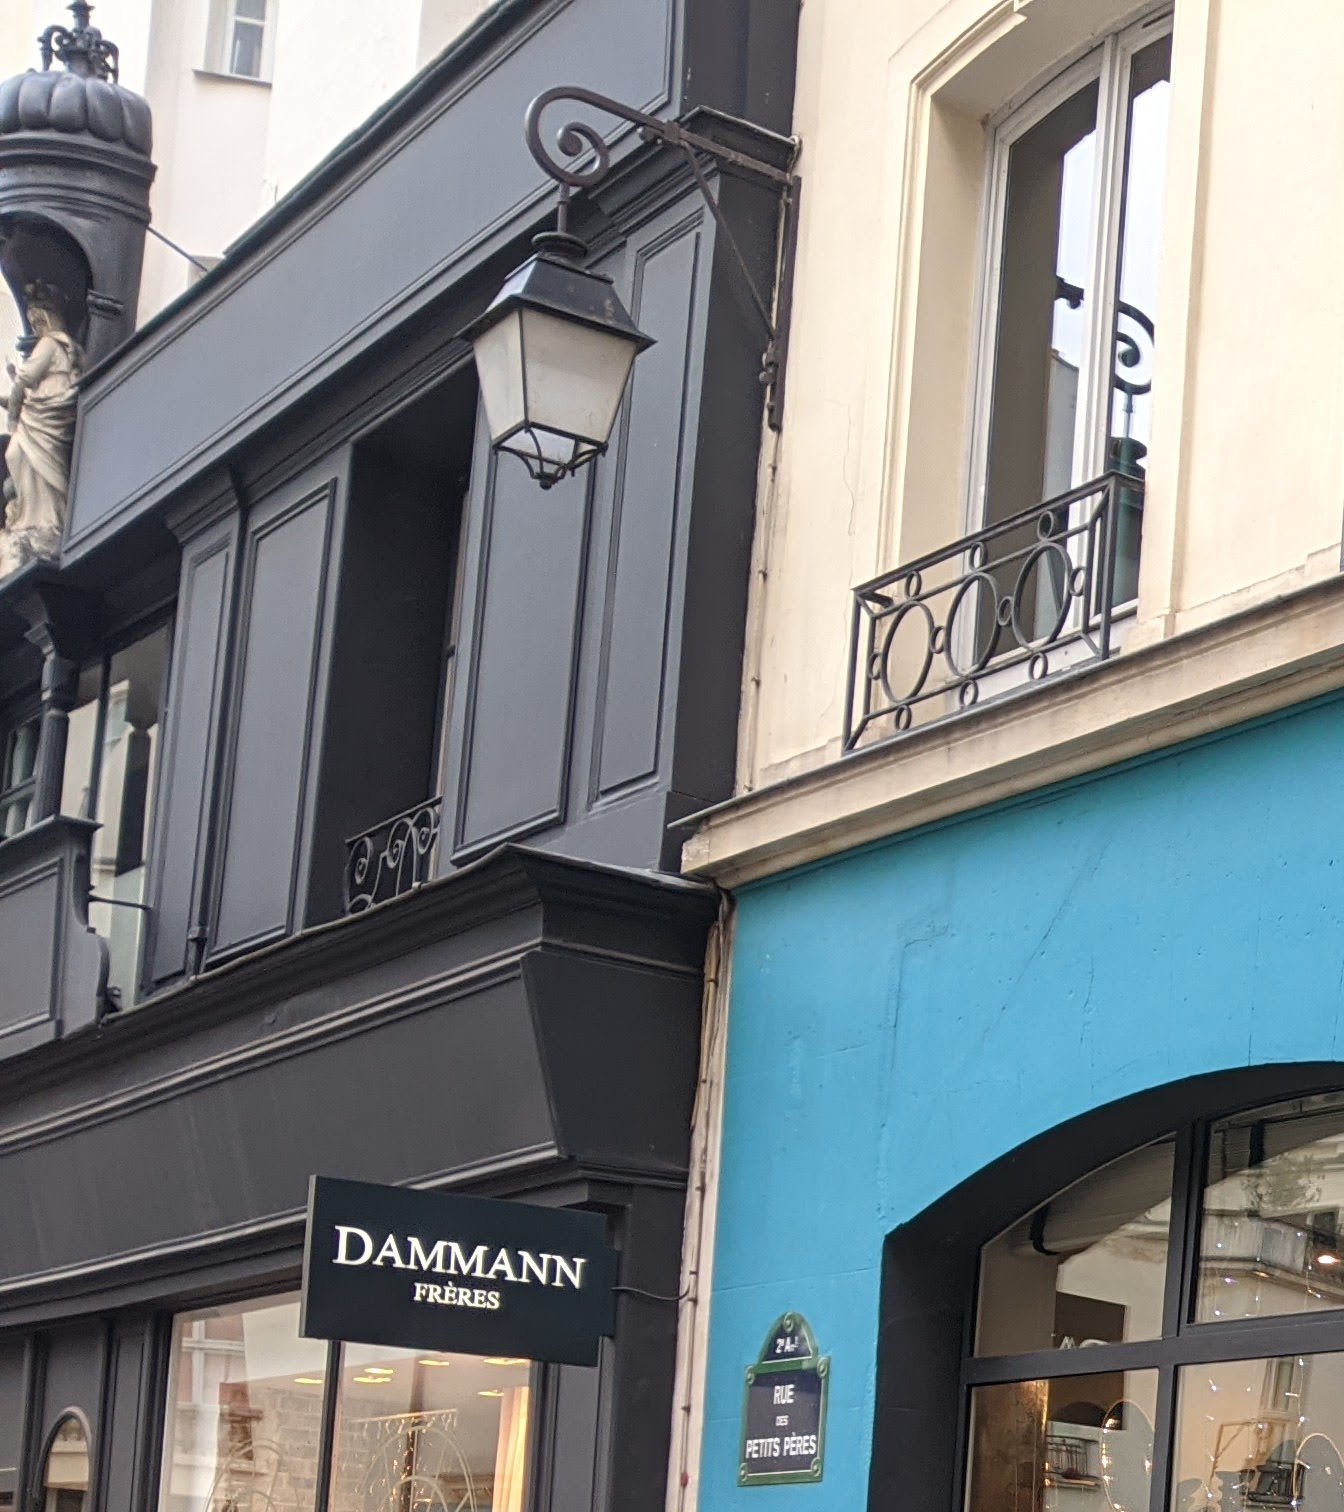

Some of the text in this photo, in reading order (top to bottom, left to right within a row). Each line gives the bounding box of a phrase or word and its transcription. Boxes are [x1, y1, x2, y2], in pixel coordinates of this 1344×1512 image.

[332, 1225, 586, 1290] DAMMANN
[413, 1281, 500, 1310] FRÈRES
[773, 1384, 795, 1404] RUE
[775, 1415, 789, 1426] DES
[745, 1432, 817, 1459] PETITS PÈRES
